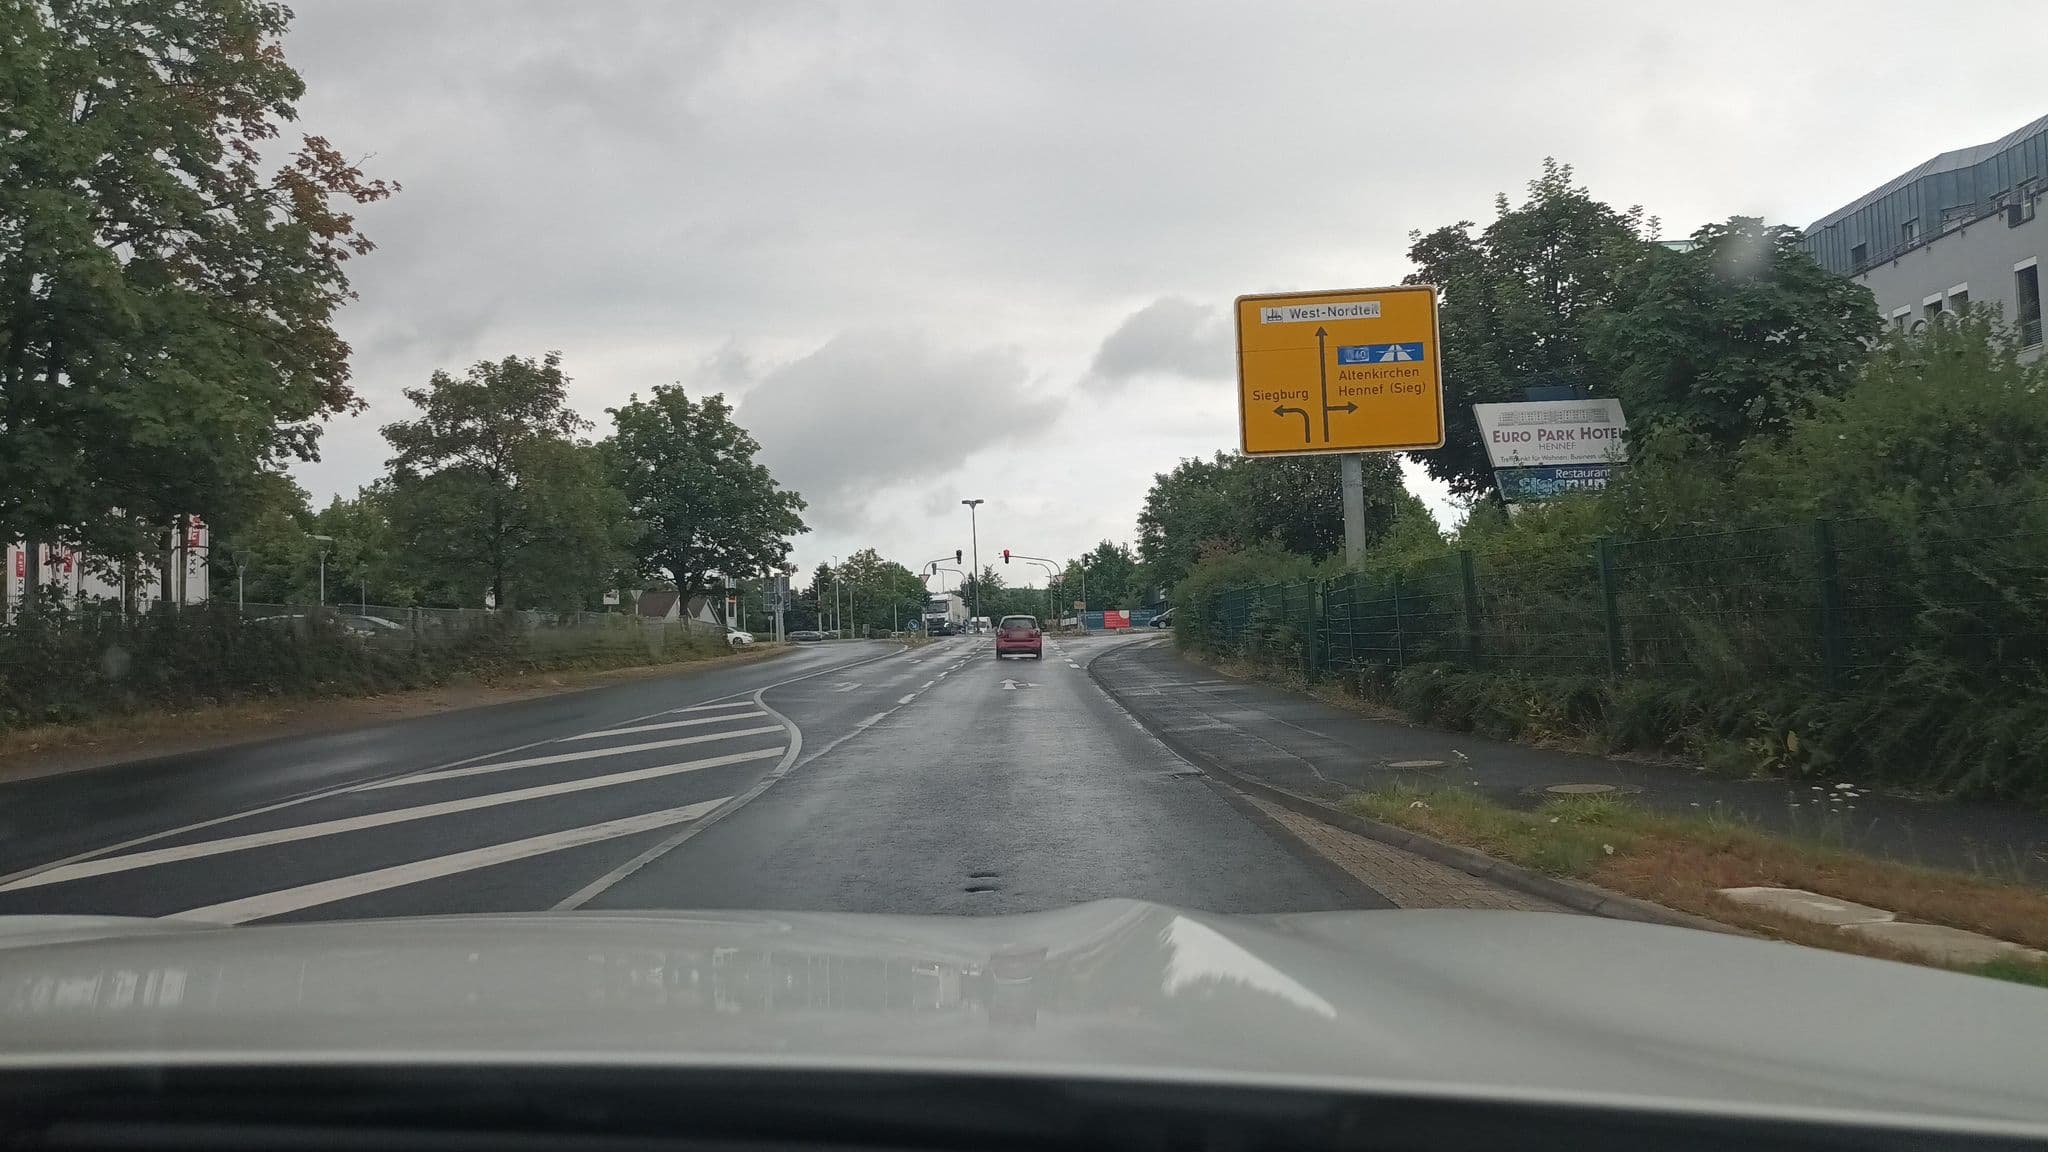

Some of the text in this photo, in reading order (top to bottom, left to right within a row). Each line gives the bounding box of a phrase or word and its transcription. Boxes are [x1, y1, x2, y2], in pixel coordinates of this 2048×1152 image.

[1289, 303, 1380, 319] West-Nordteil
[1338, 367, 1419, 381] Altenkirchen
[1252, 389, 1309, 402] Siegburg
[1338, 381, 1426, 397] Hennef (Sieg)
[1493, 430, 1531, 443] EURO
[1538, 428, 1575, 441] PARK
[1538, 443, 1577, 451] HENNEF
